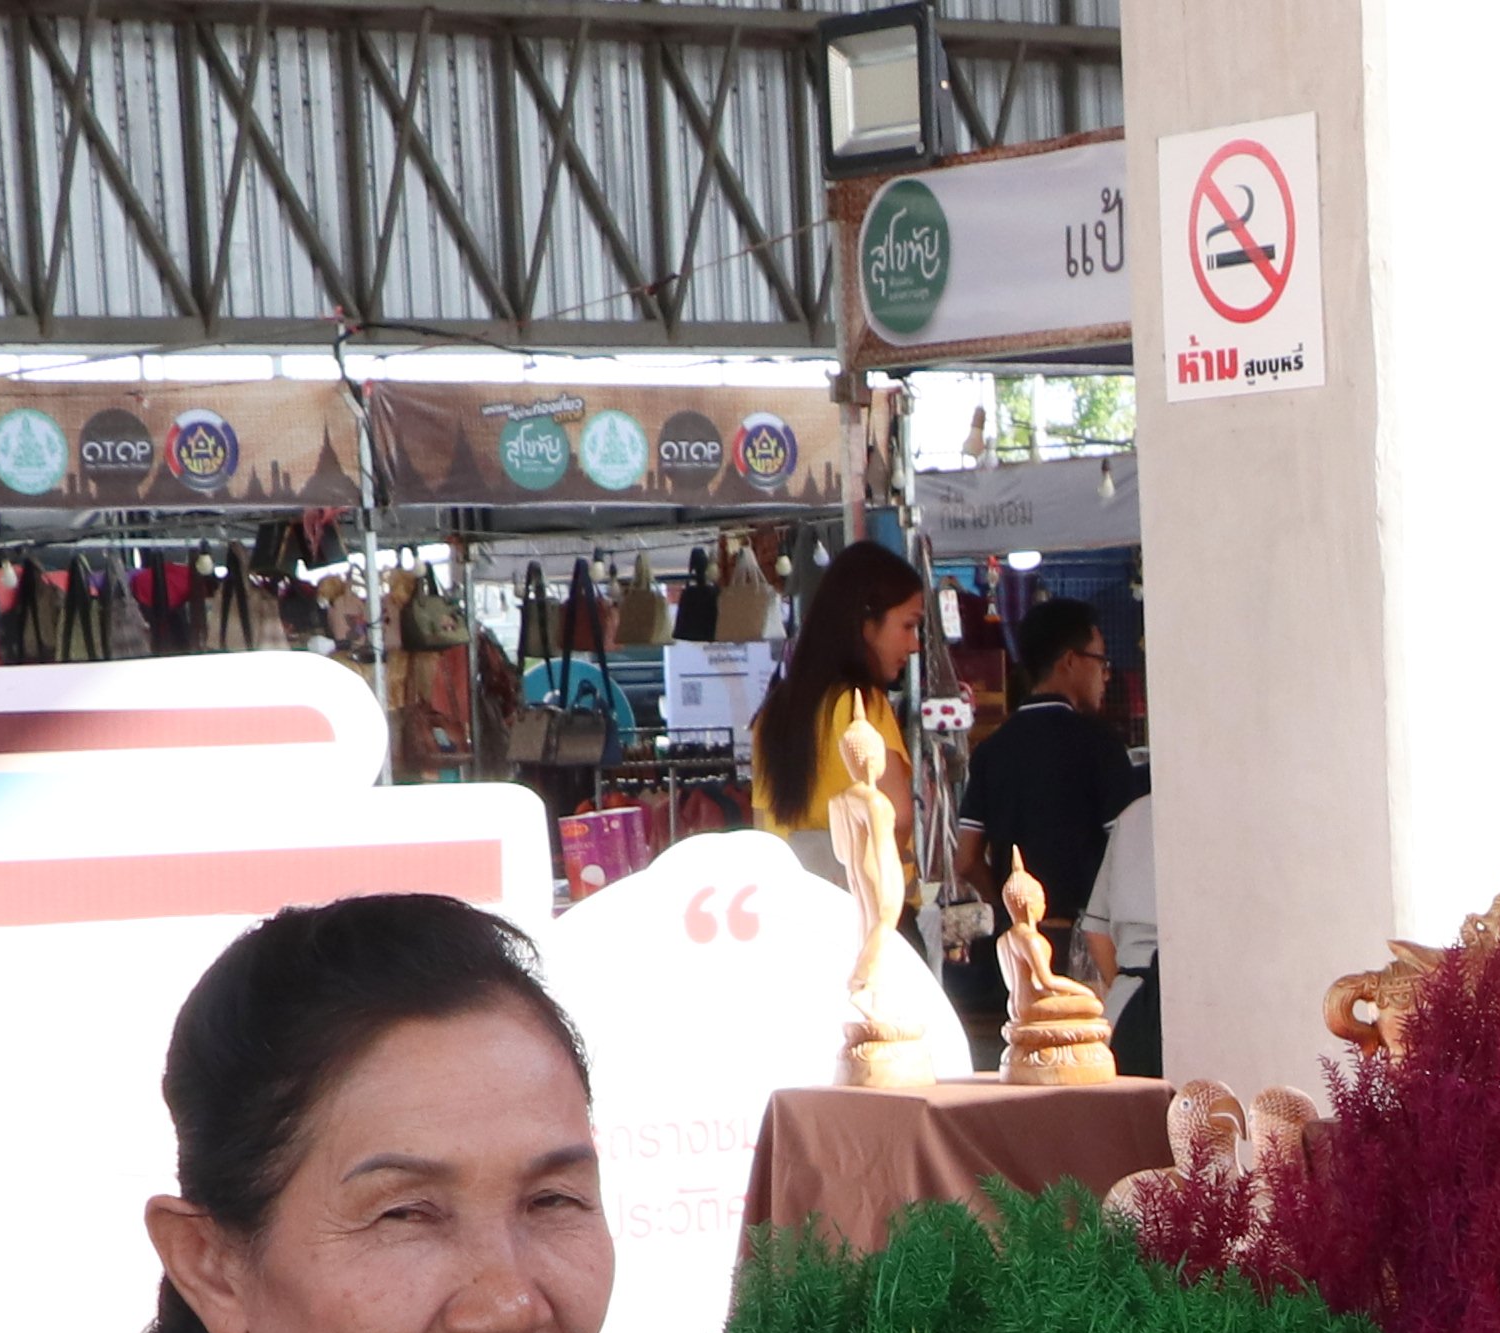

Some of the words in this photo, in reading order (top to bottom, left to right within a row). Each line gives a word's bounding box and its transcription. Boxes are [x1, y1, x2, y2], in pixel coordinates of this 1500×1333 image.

[1177, 335, 1239, 385] ห้าม
[1243, 343, 1305, 386] สูบบุหรี่
[82, 440, 151, 461] OTOP
[659, 440, 721, 460] OTOP
